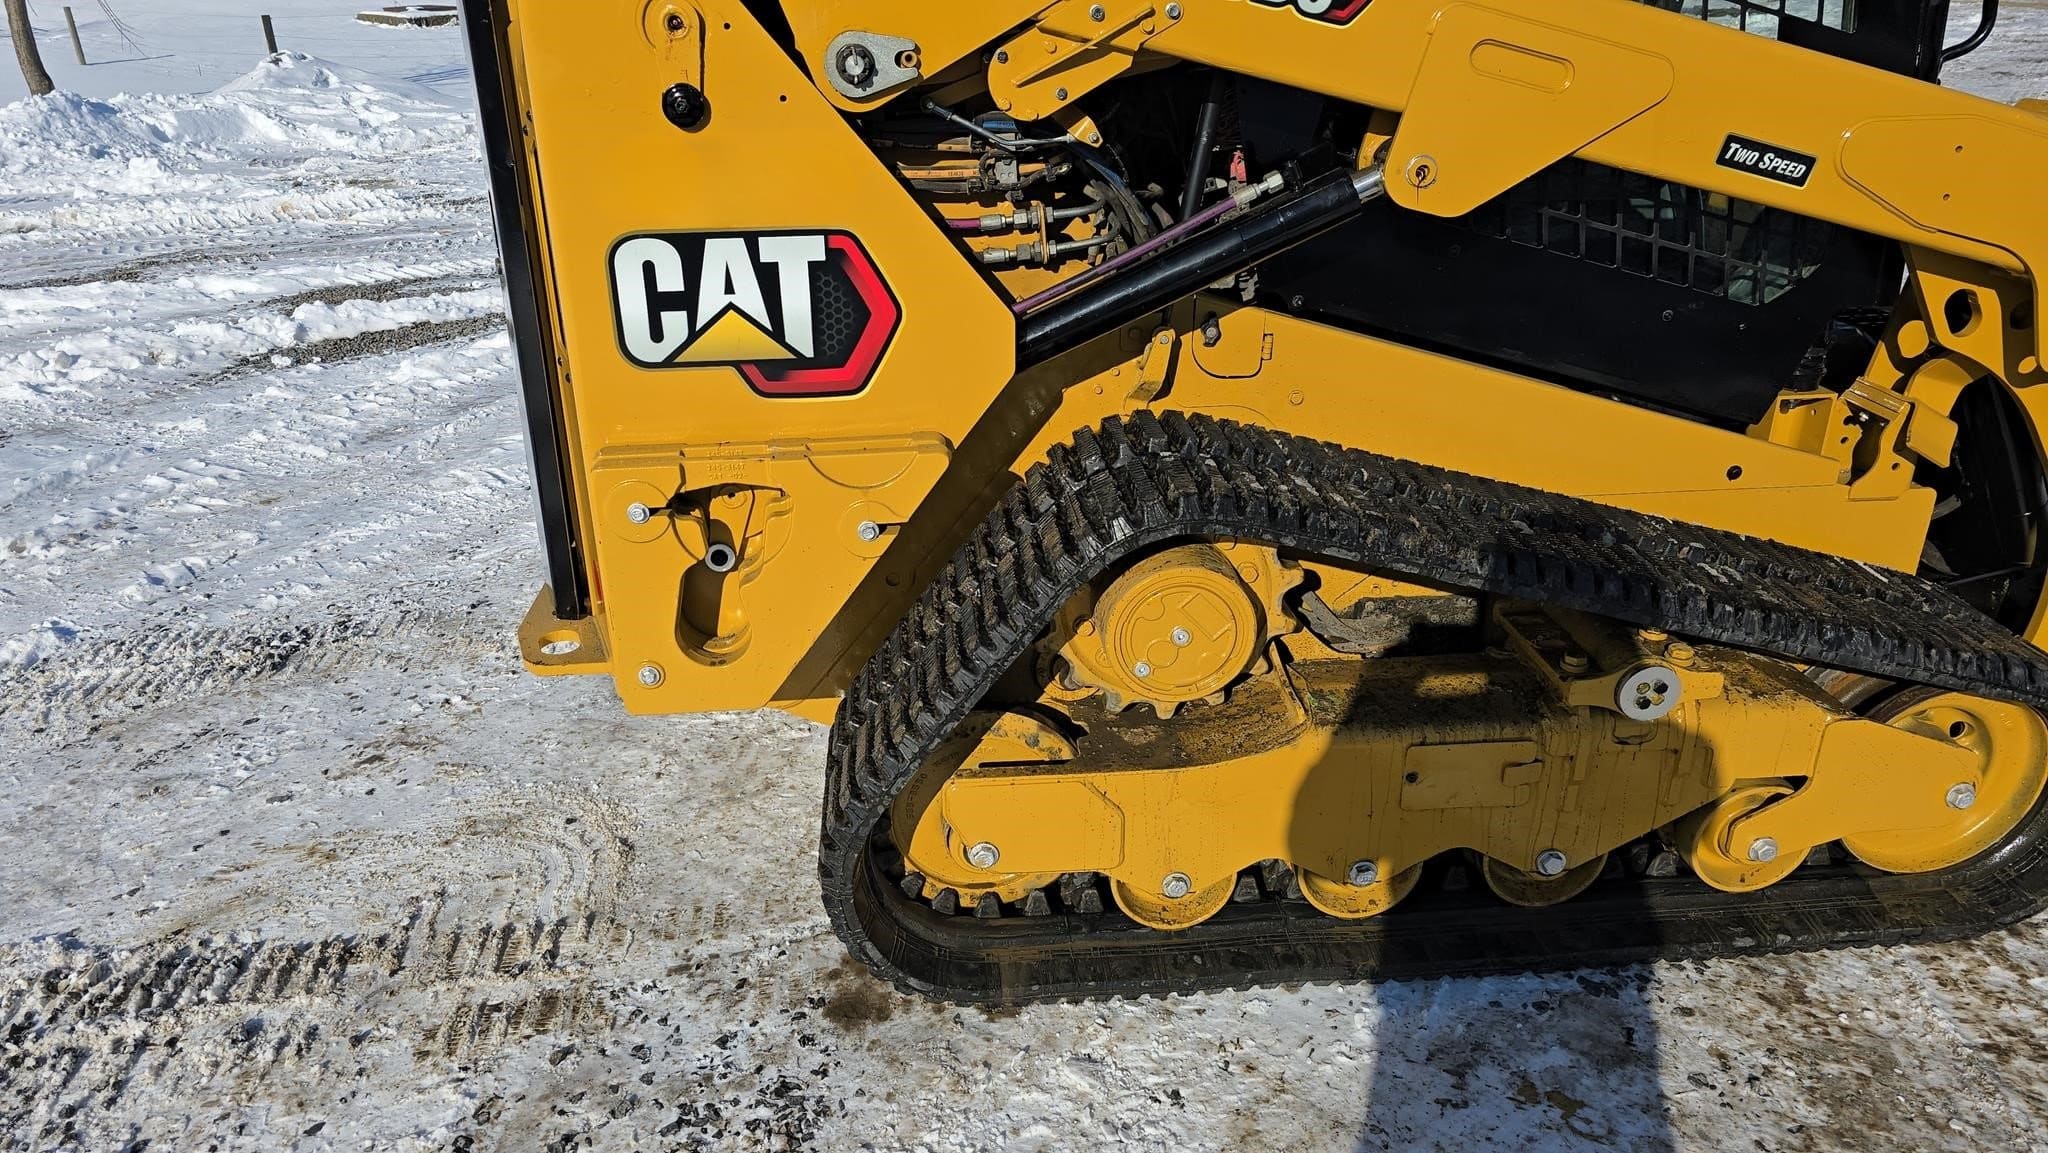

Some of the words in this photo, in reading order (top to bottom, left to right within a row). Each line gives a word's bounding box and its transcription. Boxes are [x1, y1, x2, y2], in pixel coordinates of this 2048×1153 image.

[1724, 142, 1760, 166] TWO
[1758, 152, 1807, 178] SPEED
[614, 234, 827, 363] CAT
